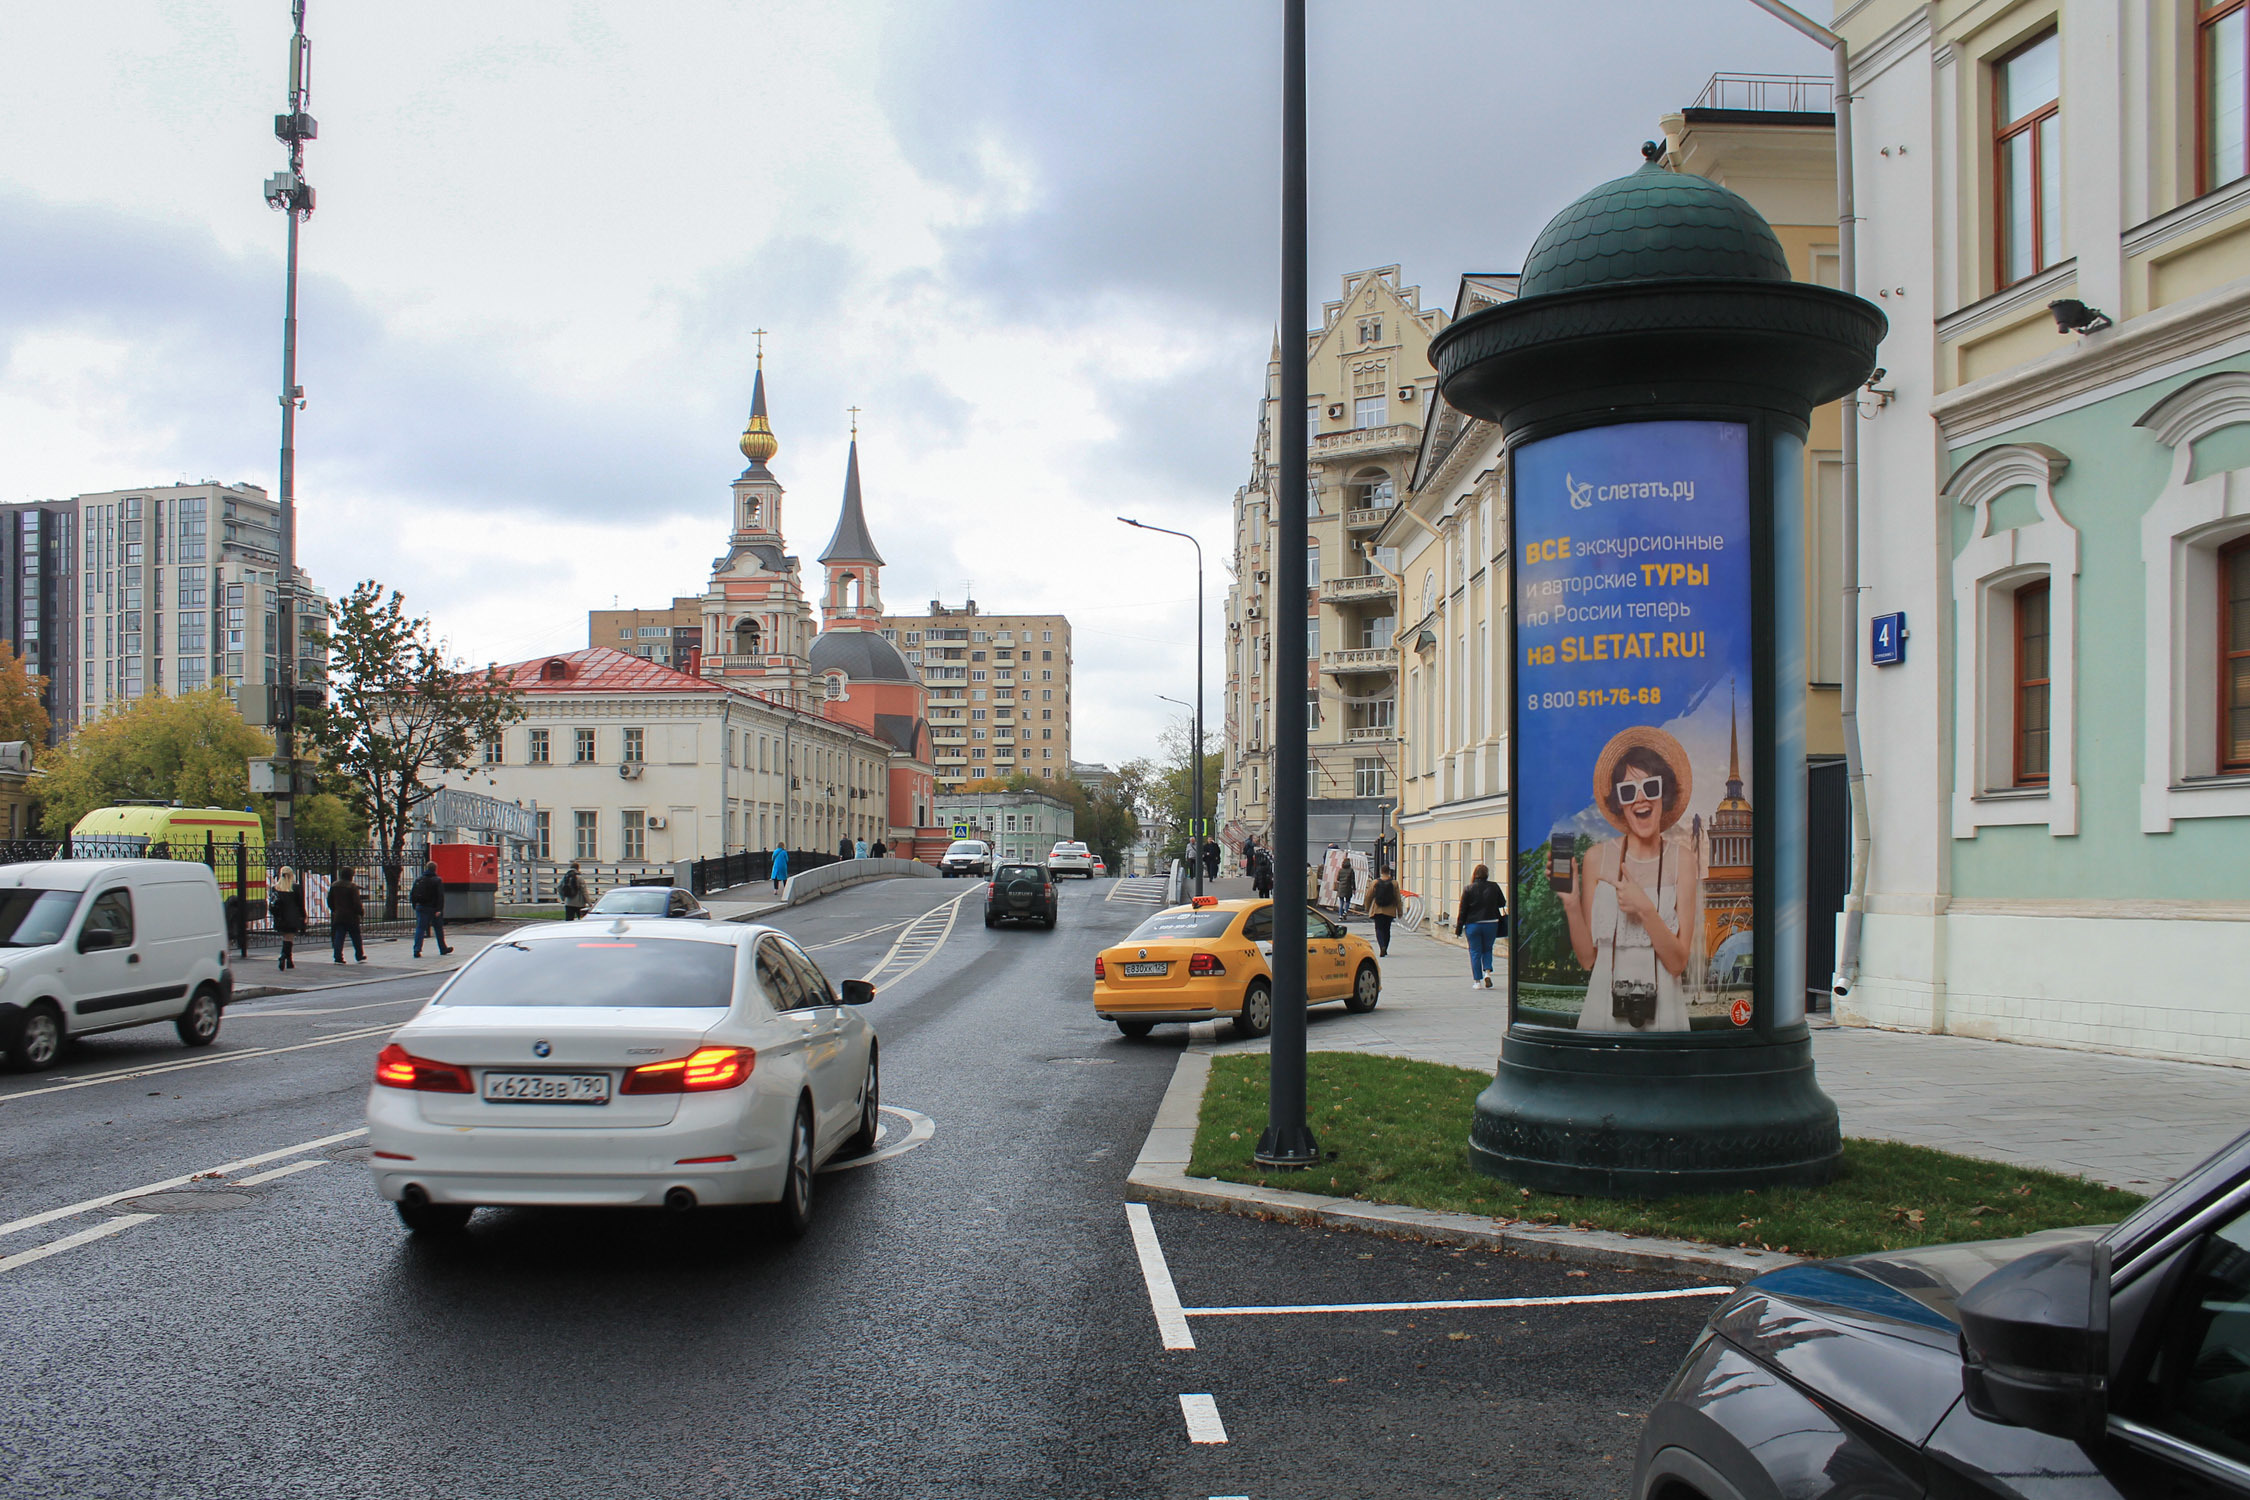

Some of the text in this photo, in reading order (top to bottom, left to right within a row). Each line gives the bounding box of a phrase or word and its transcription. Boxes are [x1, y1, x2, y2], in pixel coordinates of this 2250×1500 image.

[1598, 481, 1695, 502] слетать.ру
[1526, 535, 1724, 565] ВСЕ экскурсионные
[1526, 563, 1709, 598] и авторские ТУРЫ
[1527, 602, 1691, 628] по России теперь
[1878, 623, 1889, 647] 4
[1527, 631, 1705, 666] на SLETAT.RU!
[1528, 687, 1662, 711] 8 800 511-76-68
